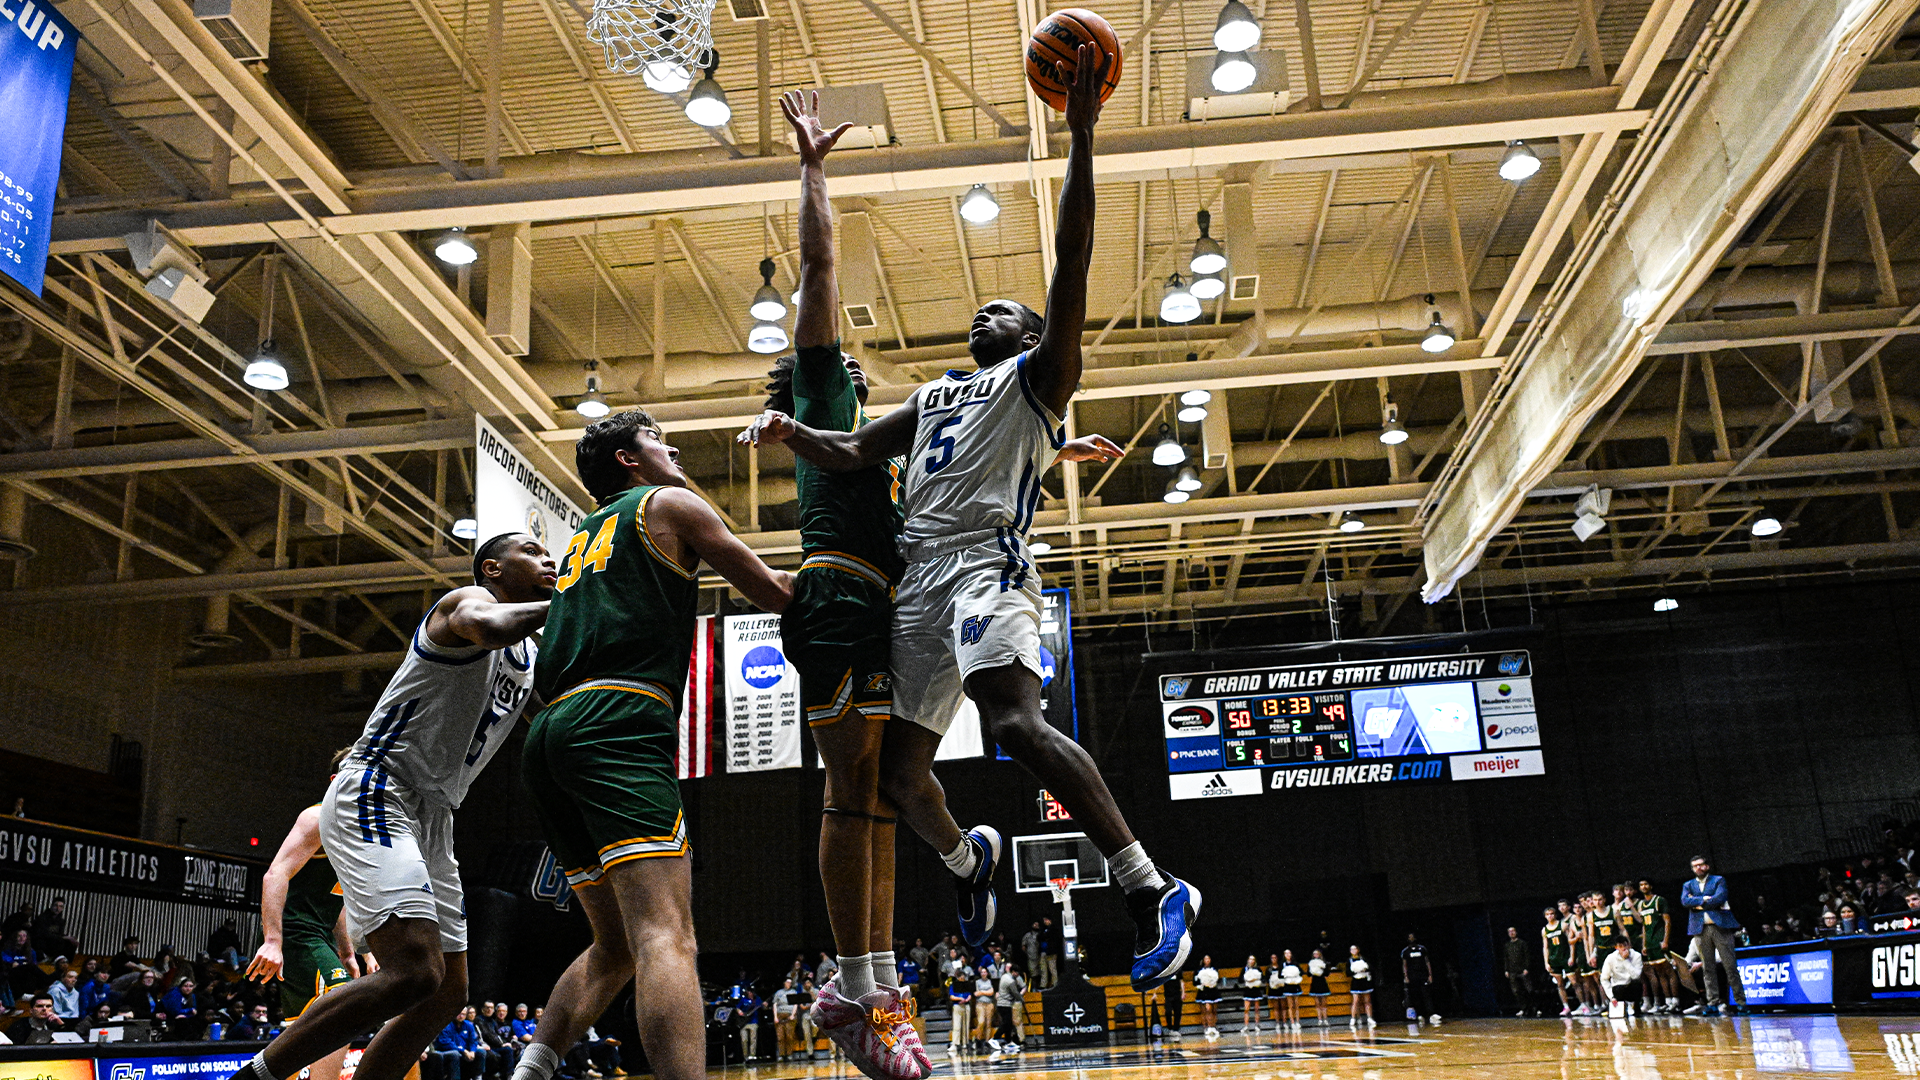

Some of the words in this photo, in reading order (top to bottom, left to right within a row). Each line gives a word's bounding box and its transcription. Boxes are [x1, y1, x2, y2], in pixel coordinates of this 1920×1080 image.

[923, 377, 996, 411] GVSU
[925, 415, 963, 474] 5
[556, 512, 620, 593] 34
[961, 614, 995, 646] GV
[745, 664, 785, 680] NCAA
[1498, 653, 1527, 675] GV
[1204, 674, 1261, 695] GRAND
[1268, 669, 1328, 689] VALLEY
[1332, 665, 1384, 685] STATE
[1388, 658, 1485, 681] UNIVERSITY
[493, 671, 529, 709] VSU
[1164, 677, 1192, 699] GV
[1224, 700, 1248, 710] HOME
[1262, 697, 1311, 717] 13:33
[1314, 694, 1345, 703] VISITOR
[1228, 710, 1252, 729] 50
[1322, 704, 1346, 722] 49
[1292, 719, 1302, 734] 2
[1505, 723, 1538, 737] pepsi
[464, 708, 502, 768] 5
[1338, 739, 1350, 753] 4
[1179, 751, 1197, 759] PNC
[1197, 749, 1219, 757] BANK
[1235, 746, 1246, 761] 5
[1254, 748, 1262, 760] 2
[1314, 744, 1323, 756] 3
[1474, 755, 1520, 774] meijer
[1270, 760, 1443, 790] GVSULAKERS.COM
[1201, 787, 1233, 797] adidas
[0, 830, 52, 867] GVSU
[60, 841, 159, 882] ATHLETICS
[184, 856, 216, 888] LONG
[217, 862, 248, 892] ROAD
[1049, 1026, 1075, 1036] Trinity
[1074, 1024, 1103, 1035] Health
[152, 1063, 187, 1076] FOLLOW
[188, 1061, 200, 1074] US
[200, 1060, 213, 1073] ON
[213, 1060, 241, 1072] SOCIAL
